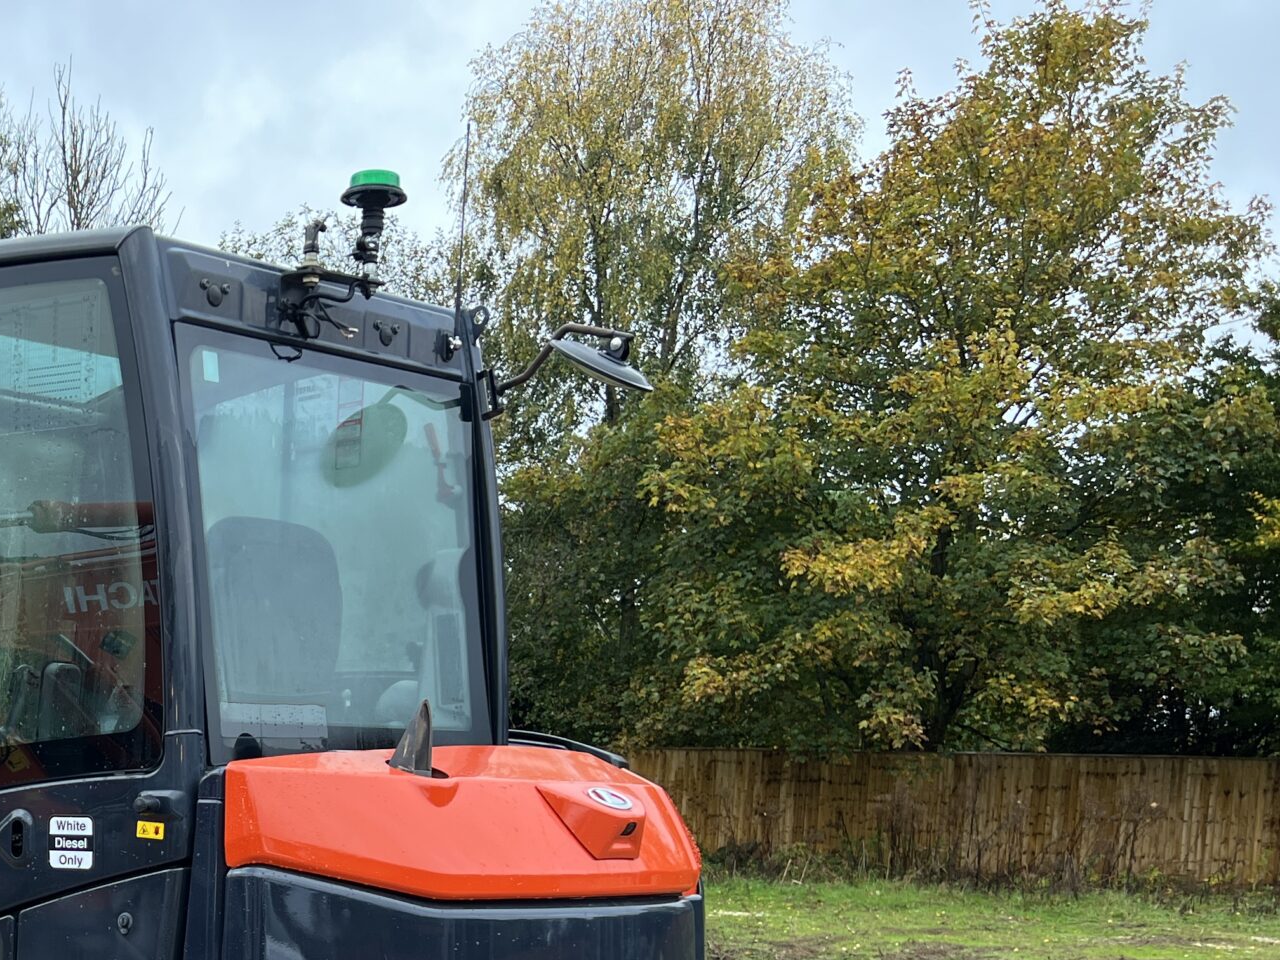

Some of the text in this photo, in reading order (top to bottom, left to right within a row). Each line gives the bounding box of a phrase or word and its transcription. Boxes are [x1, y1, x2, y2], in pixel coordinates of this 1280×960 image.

[56, 820, 87, 831] White
[54, 836, 88, 849] Diesel
[58, 854, 83, 868] Only
